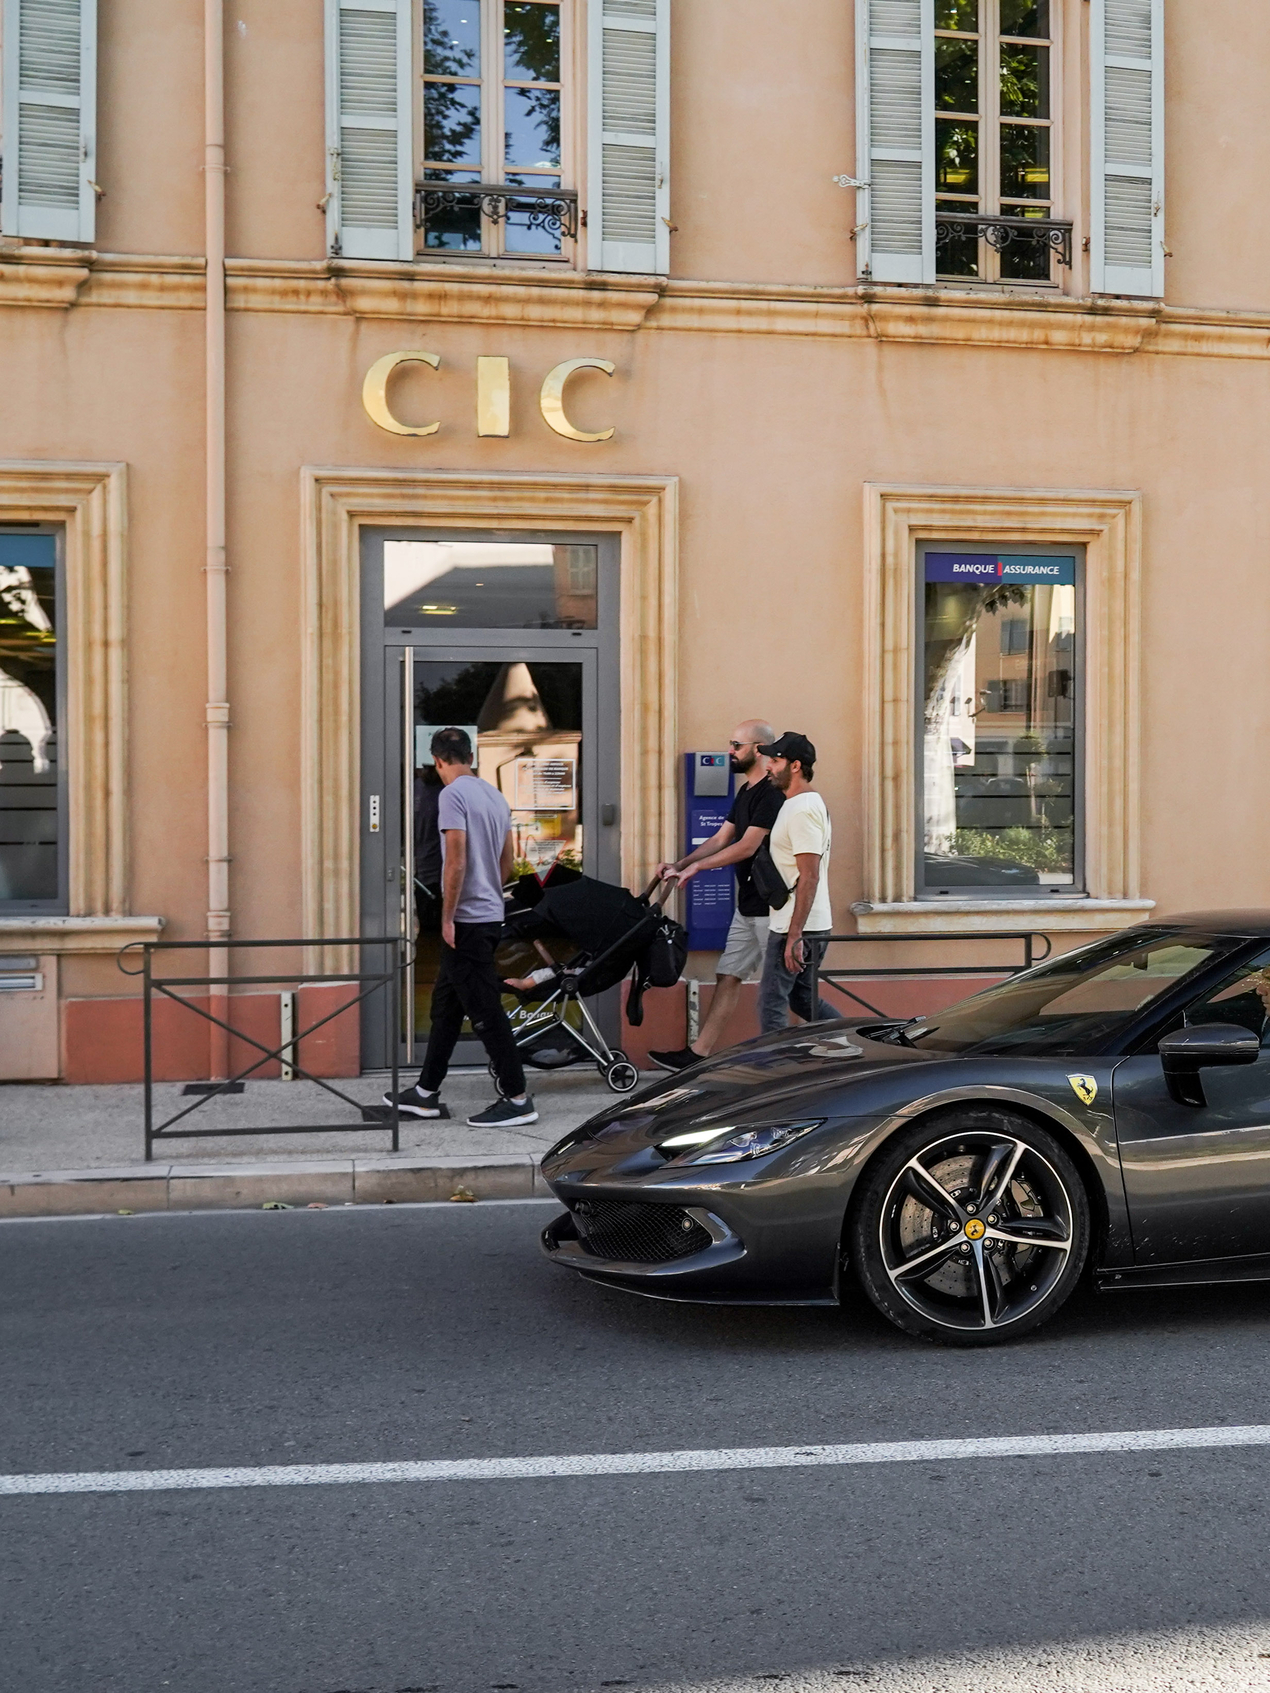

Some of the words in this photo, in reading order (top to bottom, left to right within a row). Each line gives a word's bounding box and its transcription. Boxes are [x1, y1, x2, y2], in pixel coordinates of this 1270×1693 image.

[362, 350, 616, 442] CIC
[952, 563, 995, 575] BANQUE
[1003, 565, 1060, 575] ASSURANCE
[702, 756, 723, 765] CIC
